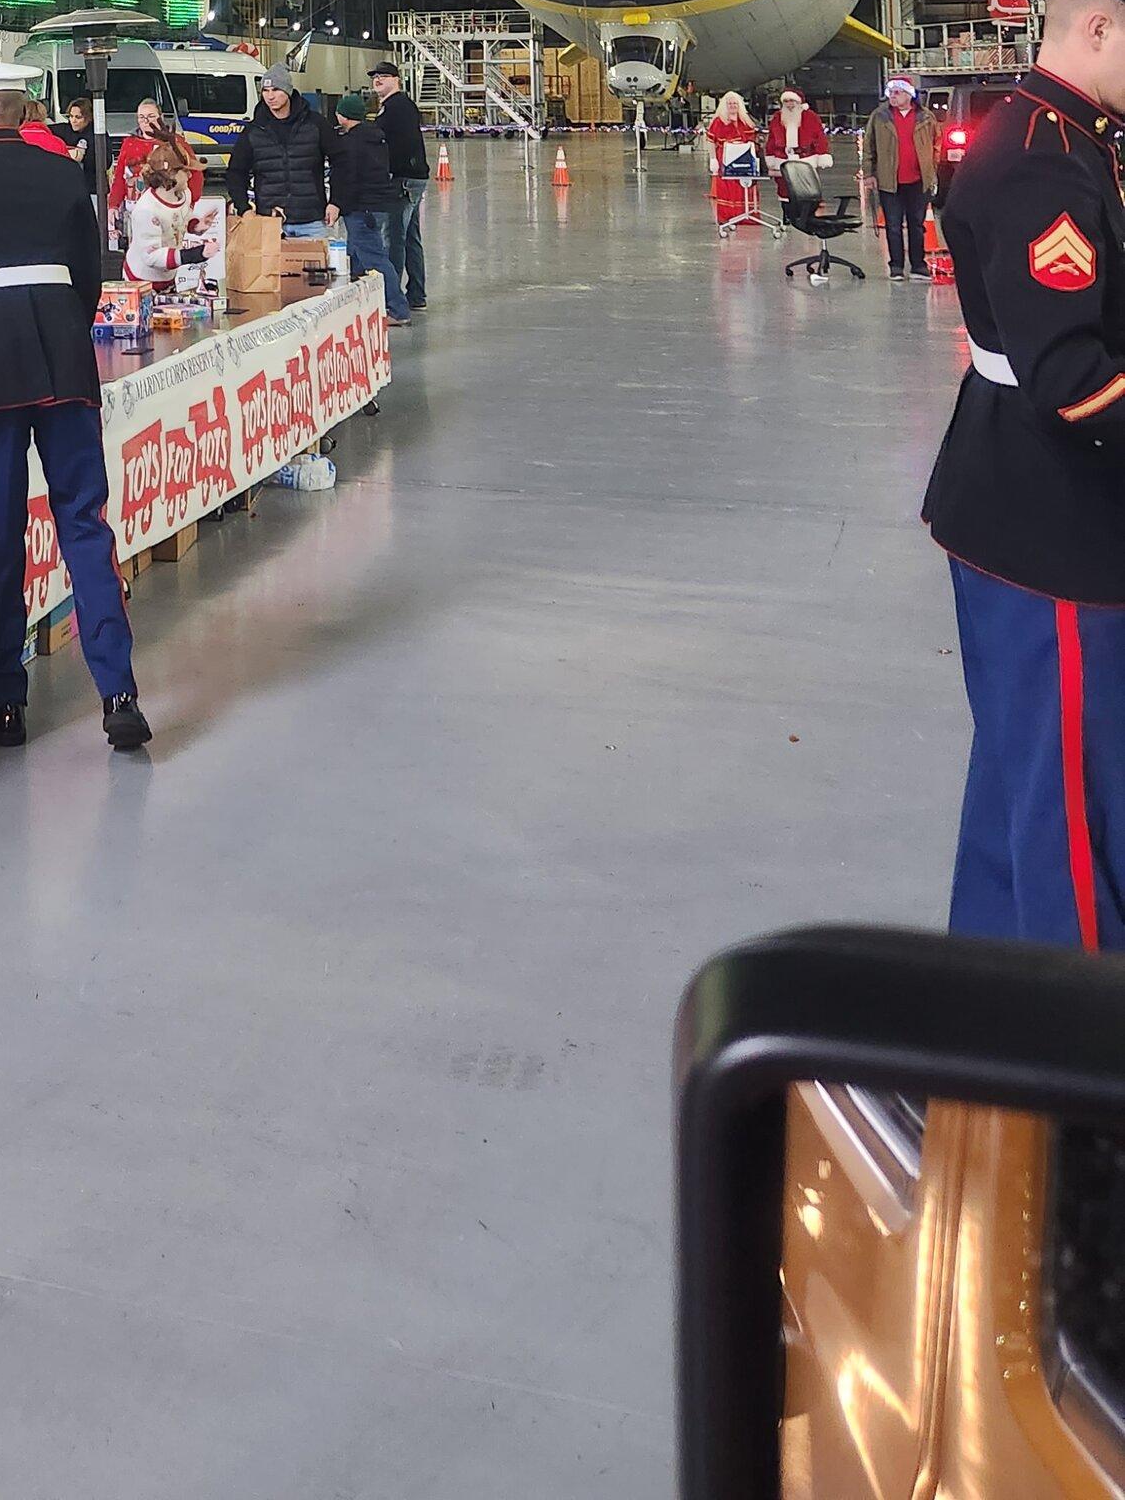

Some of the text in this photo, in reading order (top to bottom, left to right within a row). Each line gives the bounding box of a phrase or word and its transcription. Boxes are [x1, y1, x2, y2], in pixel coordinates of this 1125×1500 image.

[135, 370, 165, 401] MARINE
[242, 379, 312, 439] TOYS FOR TOTS
[126, 426, 228, 503] TOYS FOR TOTS
